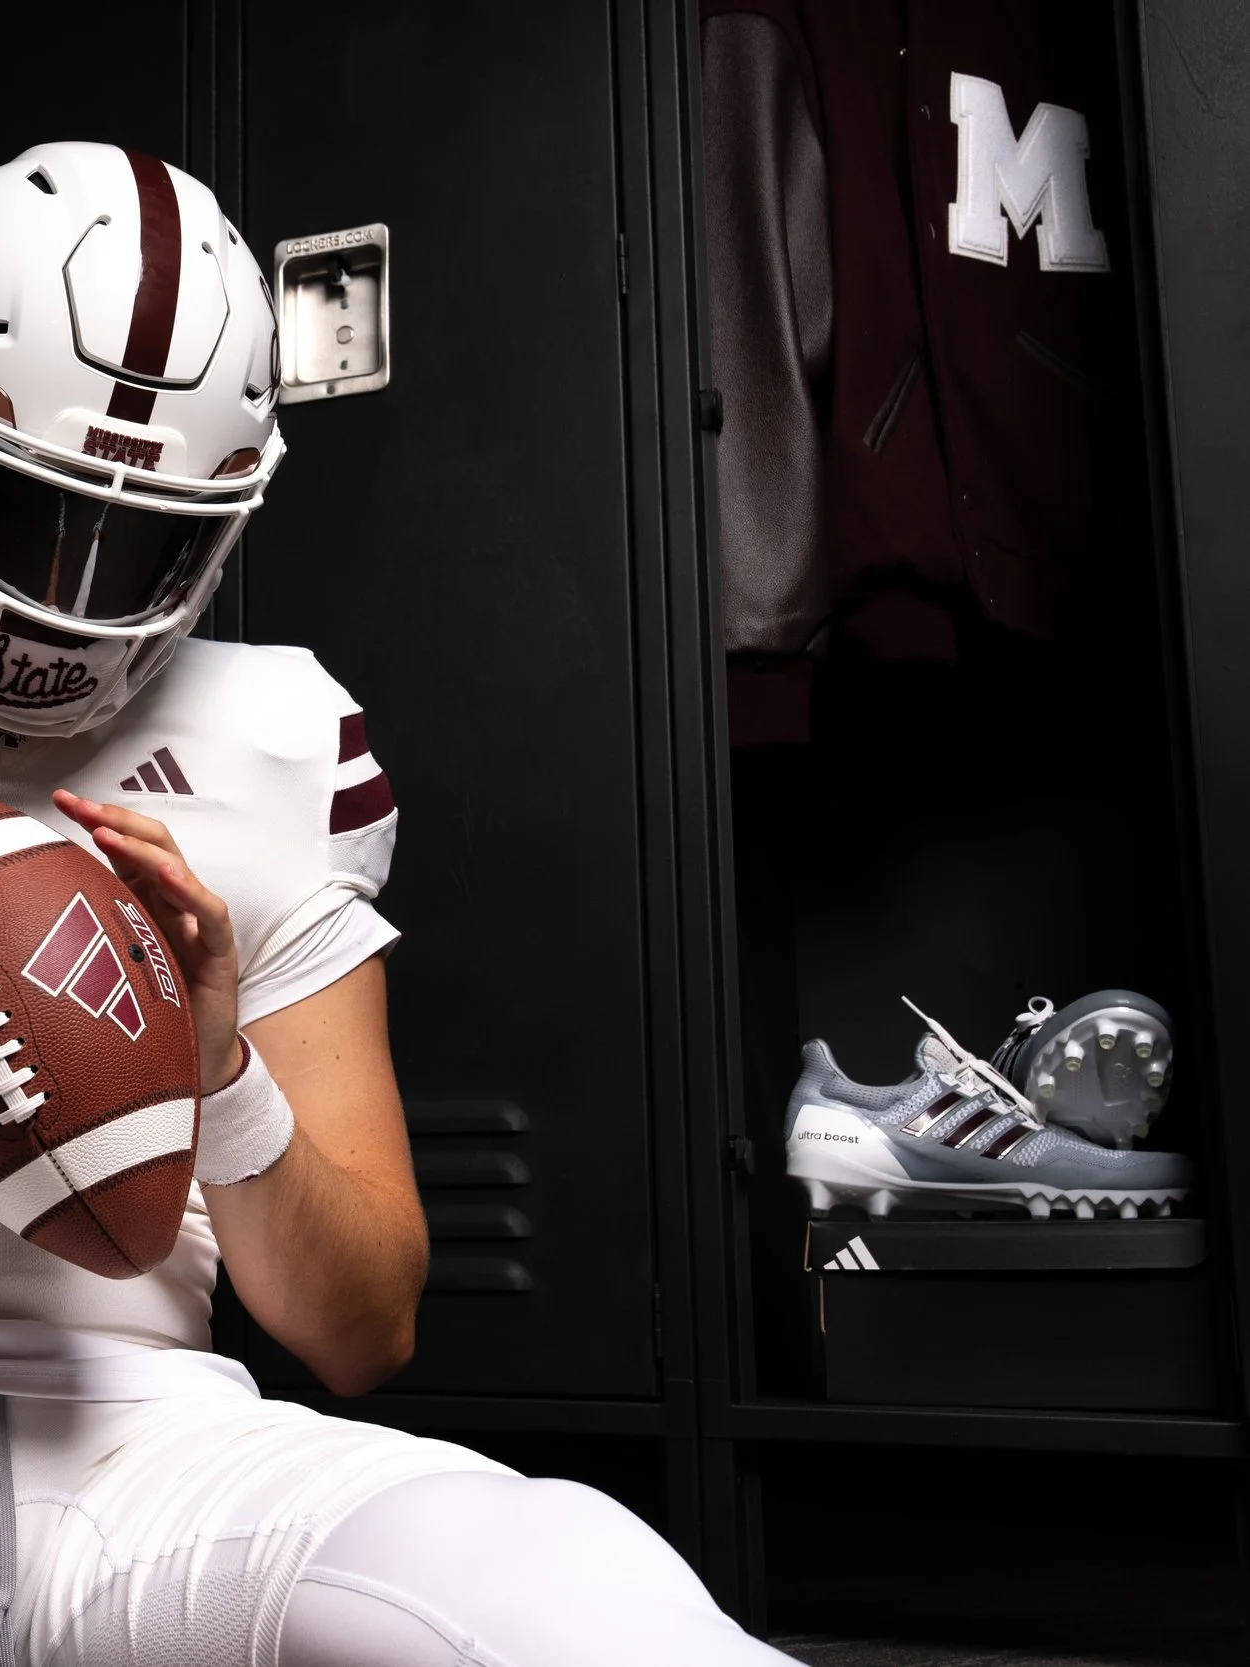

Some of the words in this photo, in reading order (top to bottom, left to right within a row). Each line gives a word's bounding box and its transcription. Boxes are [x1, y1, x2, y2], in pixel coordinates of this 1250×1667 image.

[949, 71, 1110, 273] M
[286, 229, 375, 255] LOCKERS.COM
[114, 899, 181, 1008] DIME
[797, 1130, 822, 1141] ultra
[824, 1131, 859, 1144] boost
